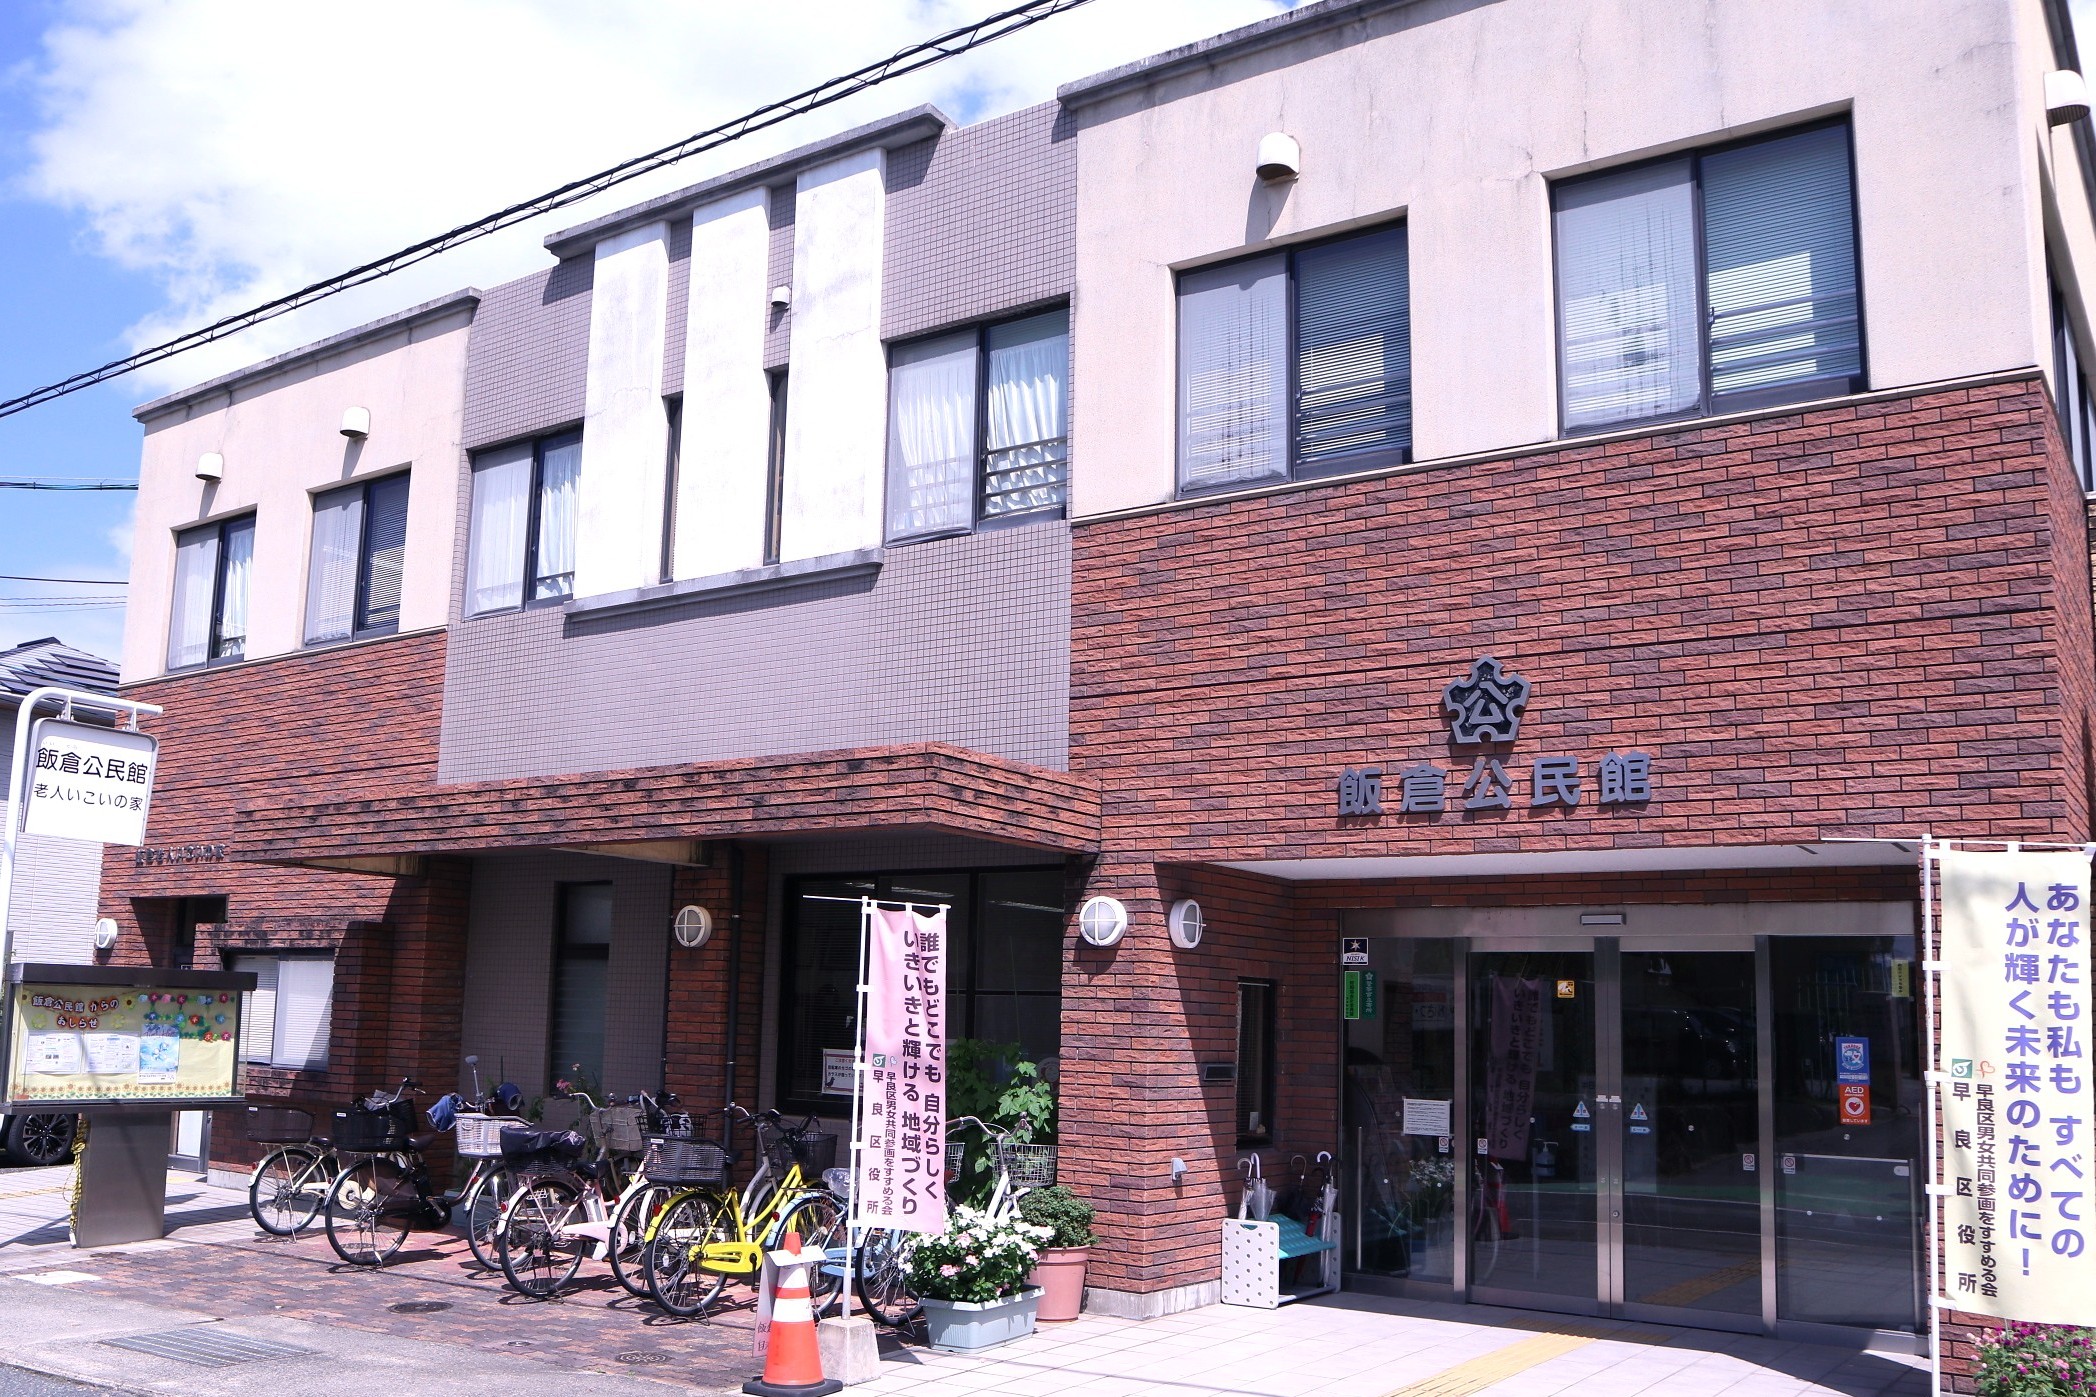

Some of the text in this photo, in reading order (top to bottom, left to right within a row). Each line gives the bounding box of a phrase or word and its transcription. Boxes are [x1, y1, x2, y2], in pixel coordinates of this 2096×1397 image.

[34, 783, 144, 812] 老人いこいの家
[36, 747, 149, 785] 飯倉公民館
[1338, 751, 1651, 816] 飯倉公民館
[32, 995, 119, 1012] 飯倉公民館 からの
[57, 1015, 98, 1028] おしらせ
[901, 930, 923, 1215] いきいきと輝ける 地域づくり
[919, 932, 942, 1200] 誰でもどこでも 自分らしく
[2046, 883, 2086, 1259] あなたも私も すべての
[866, 1070, 884, 1215] 早良区役所
[882, 1071, 897, 1216] 早良区男女共同参画をすすめる会
[1844, 1086, 1864, 1094] AED
[2004, 881, 2043, 1277] 人が輝く未来のために！
[1952, 1081, 1977, 1294] 早良区役所
[1976, 1083, 1998, 1298] 早良区男女共同参画をすすめる会
